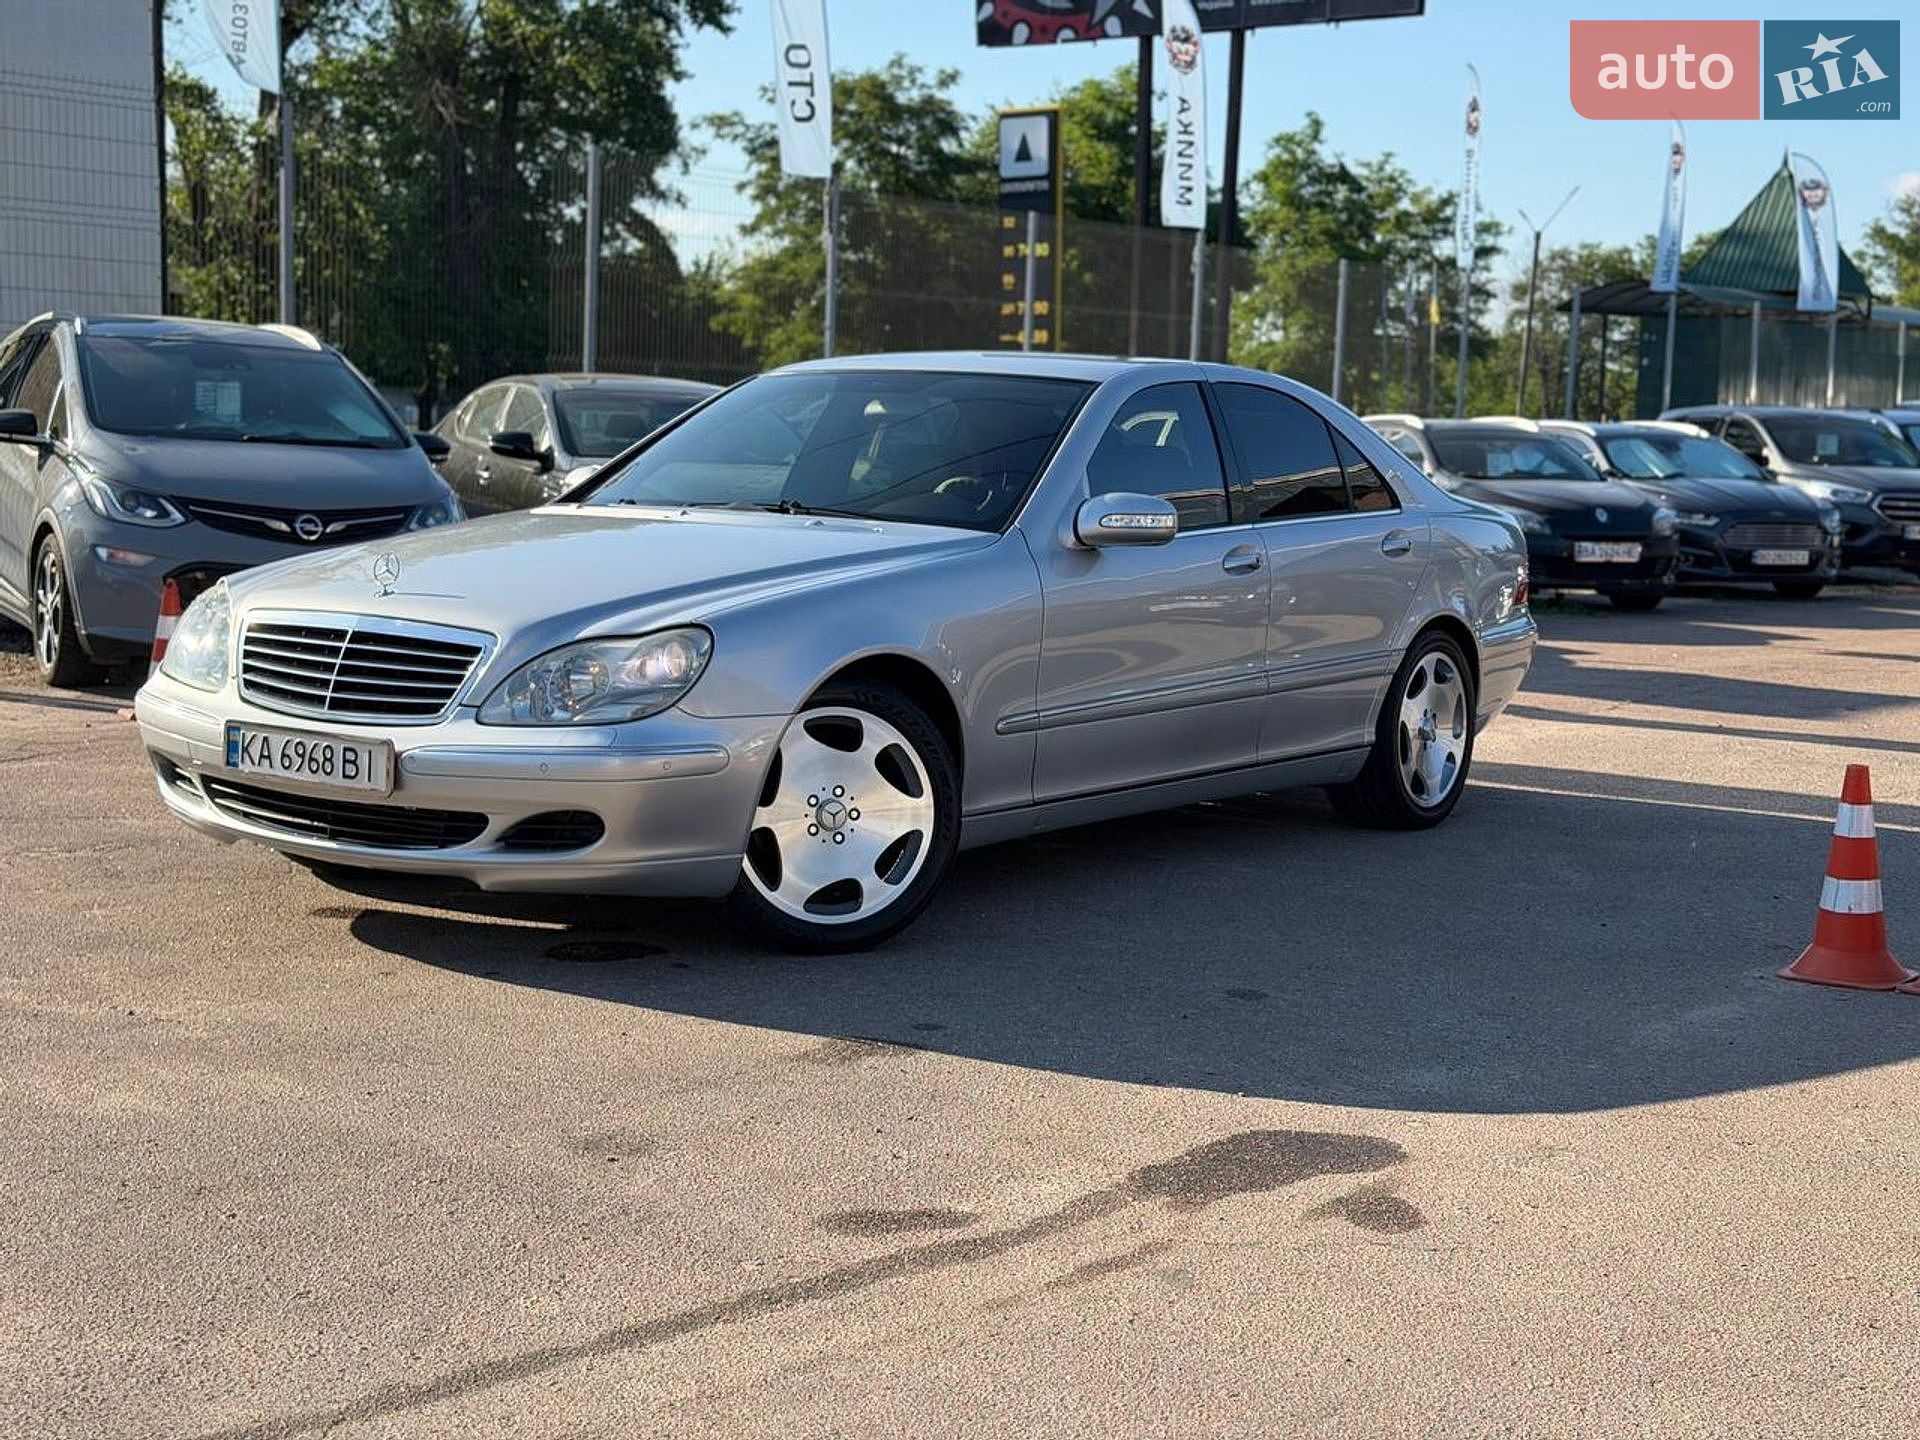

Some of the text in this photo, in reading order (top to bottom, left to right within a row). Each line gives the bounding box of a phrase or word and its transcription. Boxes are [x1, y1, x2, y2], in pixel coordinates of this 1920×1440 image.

[241, 731, 372, 783] KA 6968 BI
